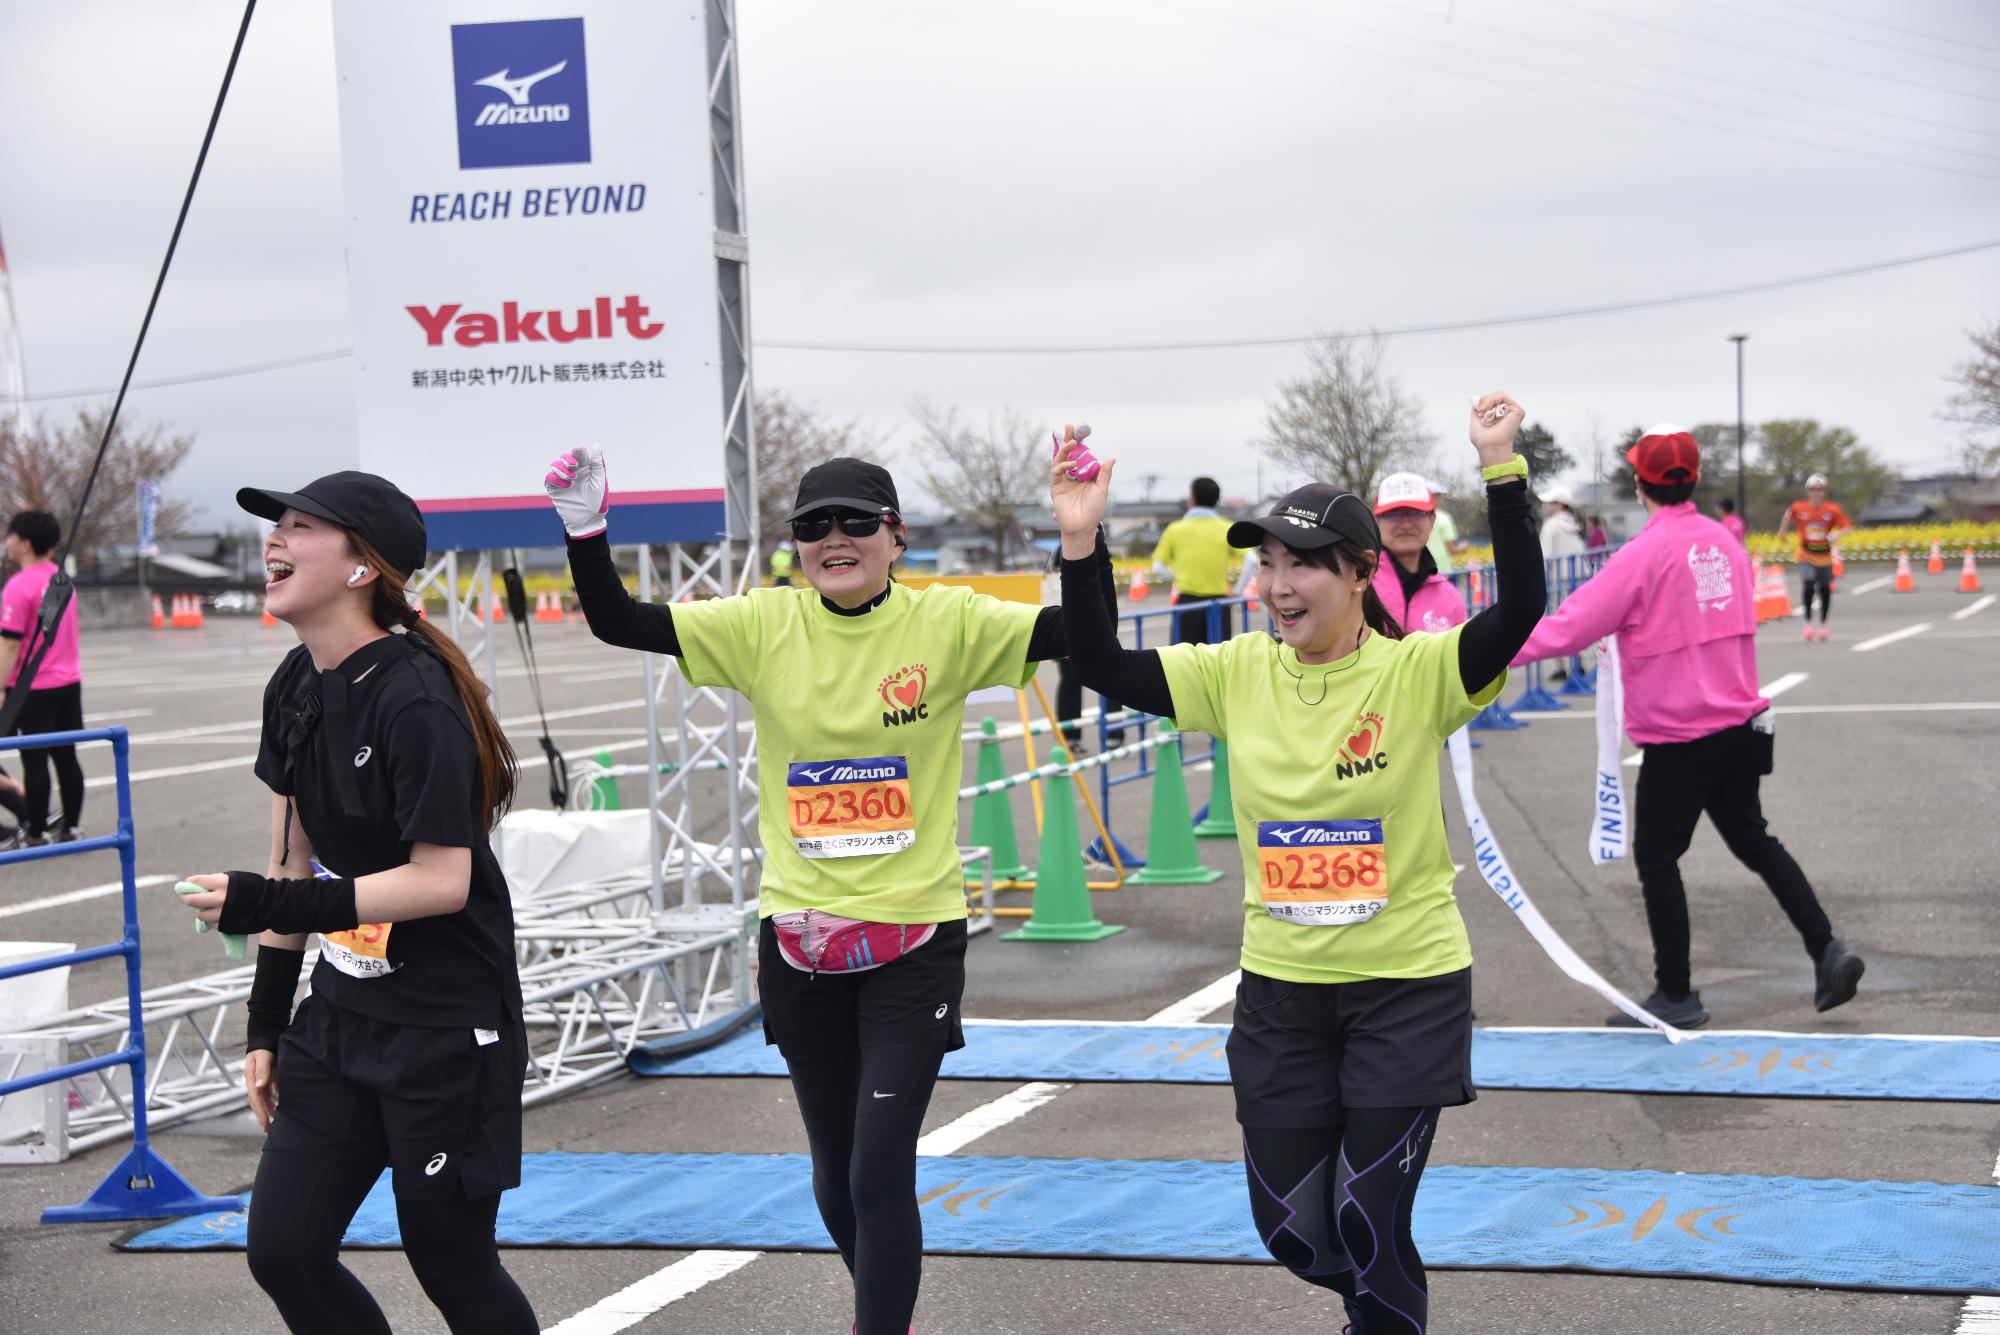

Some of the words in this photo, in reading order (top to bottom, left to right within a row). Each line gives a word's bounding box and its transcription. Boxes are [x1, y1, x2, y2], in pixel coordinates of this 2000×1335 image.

[409, 191, 511, 224] REACH
[522, 183, 647, 218] BEYOND
[405, 295, 665, 348] Yakult
[412, 360, 666, 388] 新潟中央ヤクルト販売株式会社
[883, 703, 928, 727] NMC
[1336, 752, 1387, 780] NMC
[795, 787, 905, 826] D2360
[1600, 771, 1622, 860] FINISH
[1265, 851, 1380, 889] D2368
